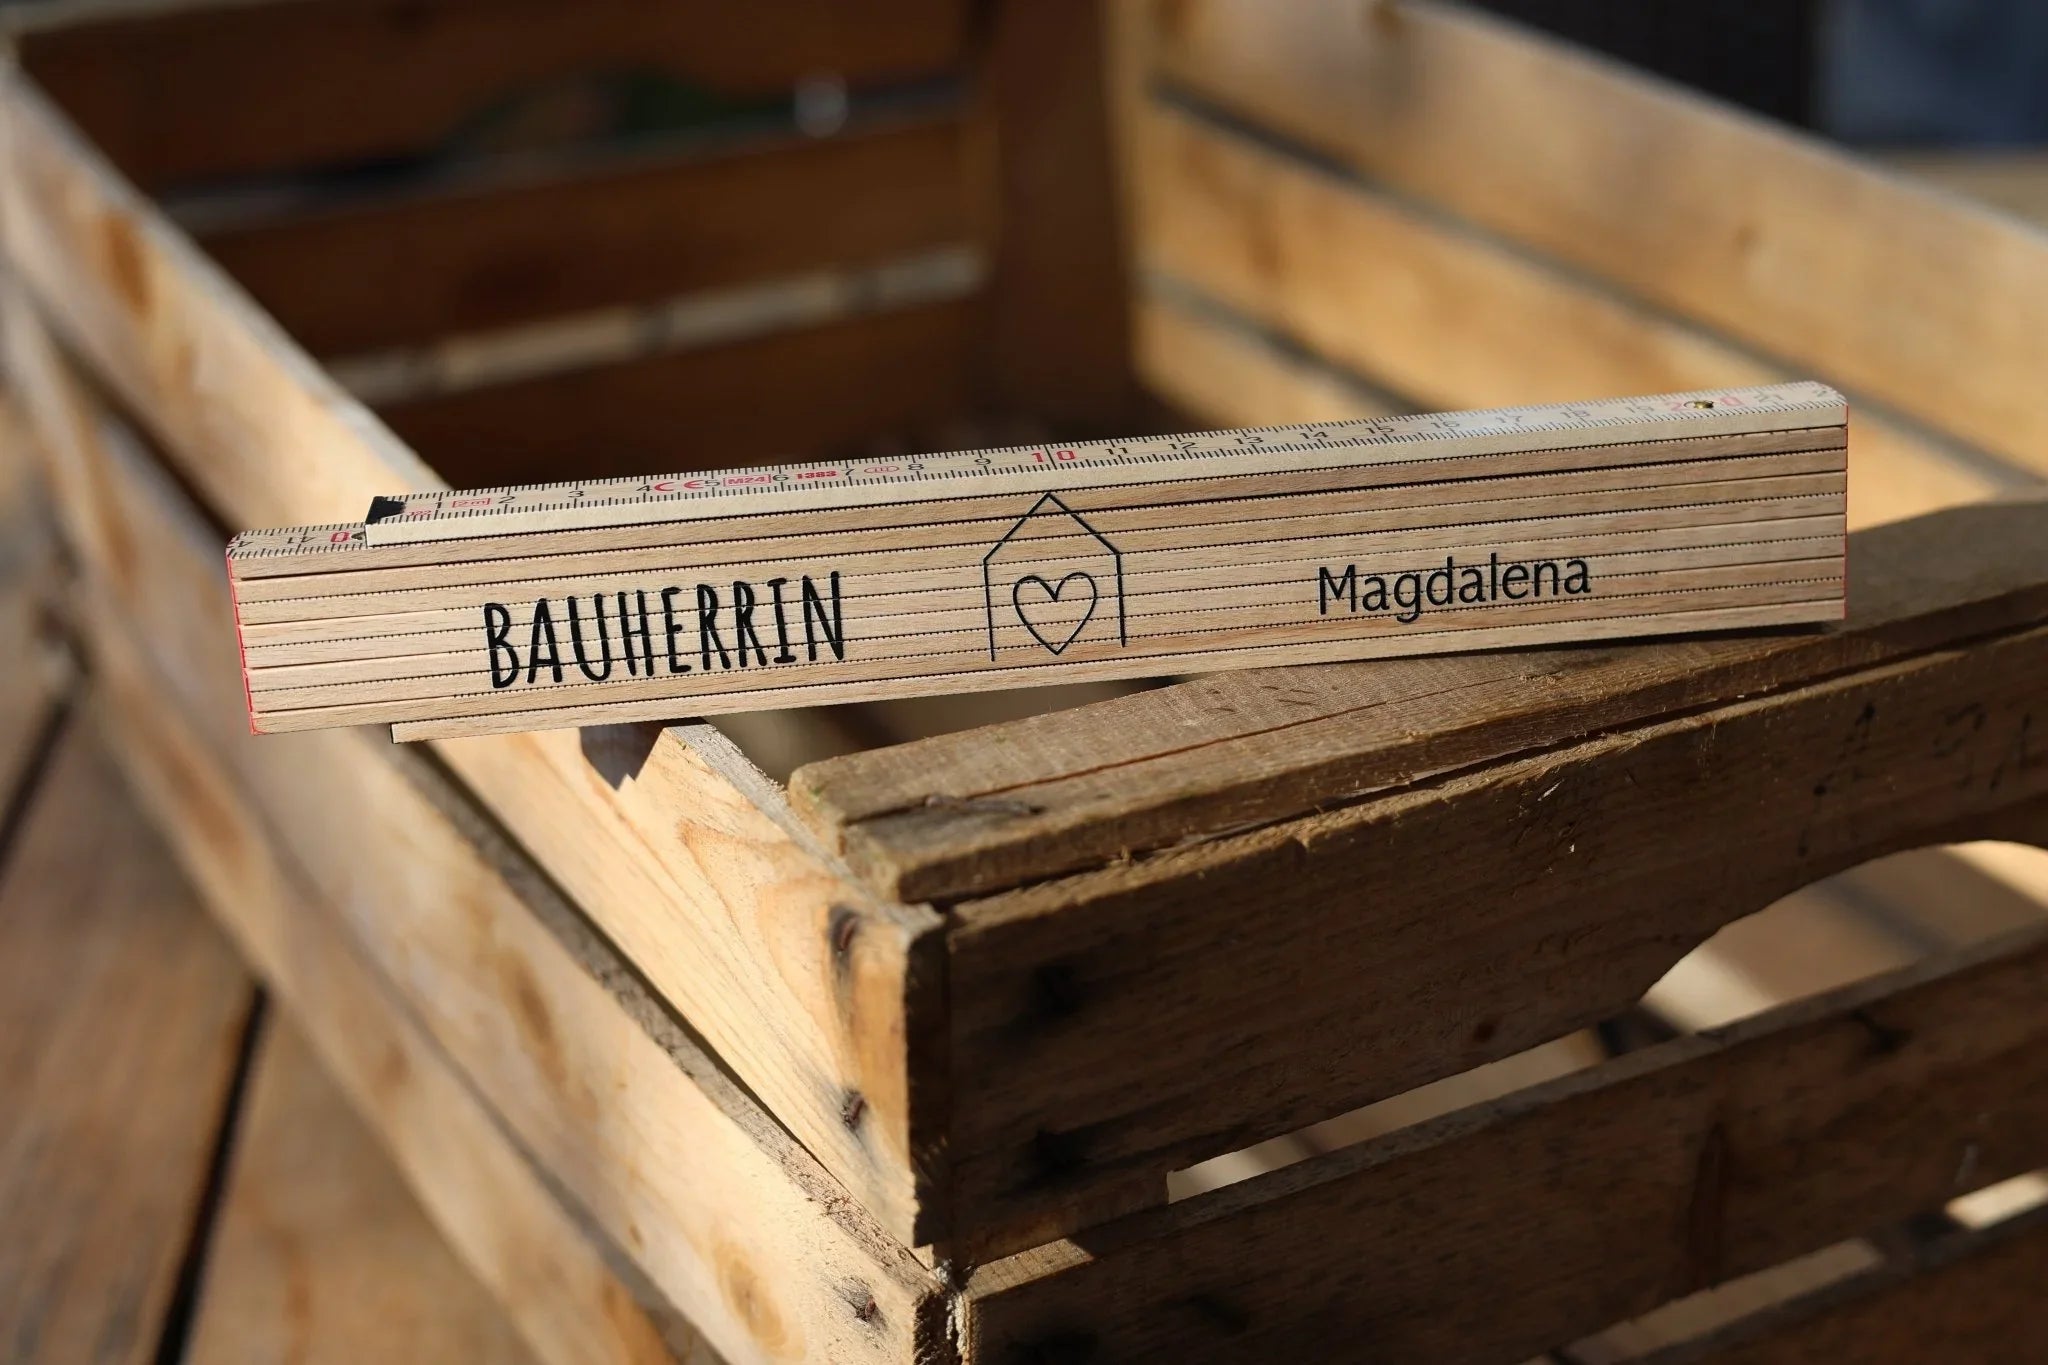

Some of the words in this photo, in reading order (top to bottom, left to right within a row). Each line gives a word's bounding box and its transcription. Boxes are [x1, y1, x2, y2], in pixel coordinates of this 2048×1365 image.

[498, 496, 516, 504] 2
[568, 490, 585, 498] 3
[636, 484, 653, 492] 4
[704, 479, 721, 487] 5
[772, 474, 789, 482] 6
[841, 468, 855, 476] 7
[907, 463, 925, 471] 8
[974, 457, 992, 466] 9
[1031, 450, 1078, 463] 10
[1105, 447, 1129, 455] 11
[1168, 442, 1197, 450] 12
[1234, 436, 1264, 445] 13
[1300, 431, 1330, 440] 14
[1366, 426, 1395, 435] 15
[1430, 420, 1460, 429] 16
[1496, 415, 1523, 424] 17
[1560, 410, 1591, 419] 18
[727, 475, 766, 485] M24
[796, 470, 837, 480] 1383
[1318, 552, 1592, 624] Magdalena
[484, 571, 844, 689] BAUHERRIN
